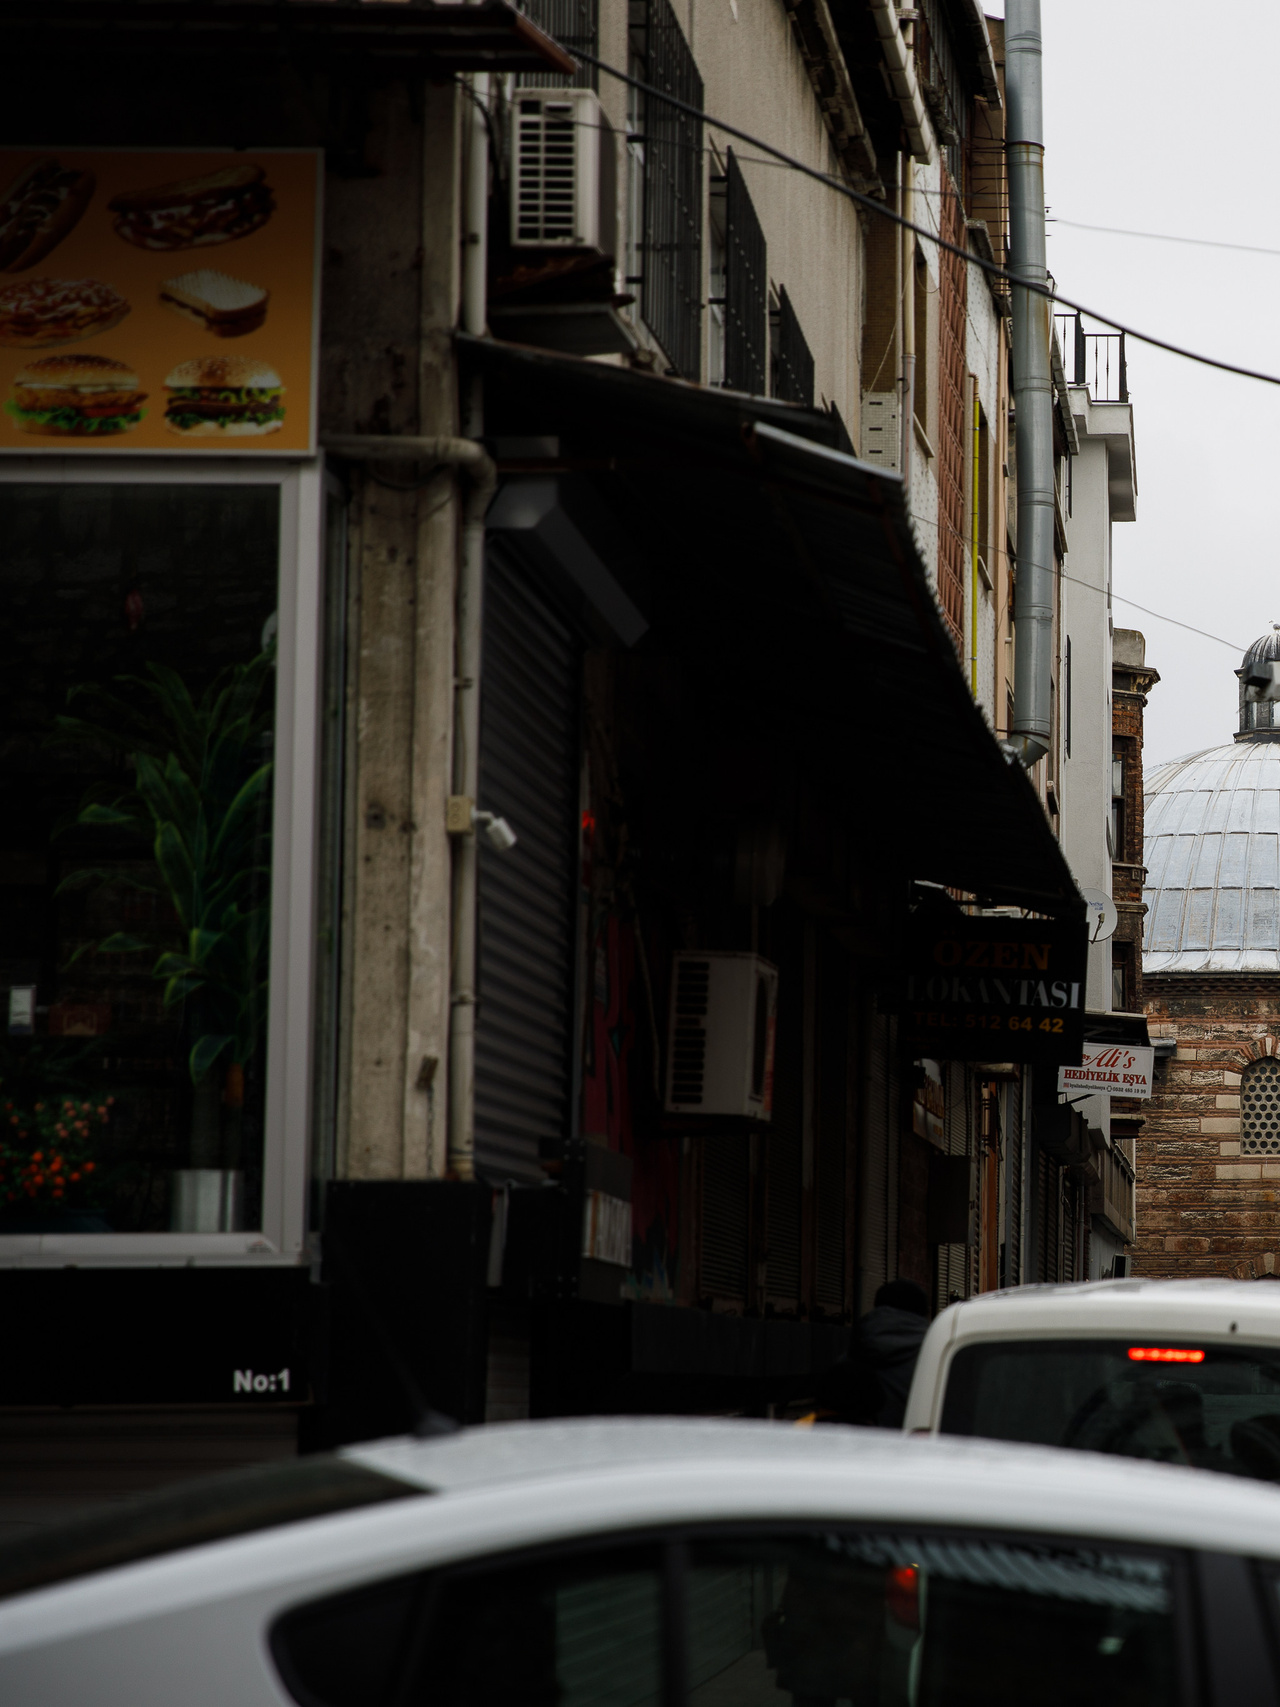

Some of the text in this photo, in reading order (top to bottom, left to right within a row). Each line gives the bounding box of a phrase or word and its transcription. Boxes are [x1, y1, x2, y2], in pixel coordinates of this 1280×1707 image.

[932, 928, 1053, 971] ÖZEN
[906, 974, 1082, 1010] LOKANTASI
[912, 1011, 1065, 1034] TEL: 512 64 42
[1082, 1048, 1135, 1069] Ali's
[1064, 1068, 1147, 1086] HEDİYELİK EŞYA
[232, 1367, 291, 1394] No:1
